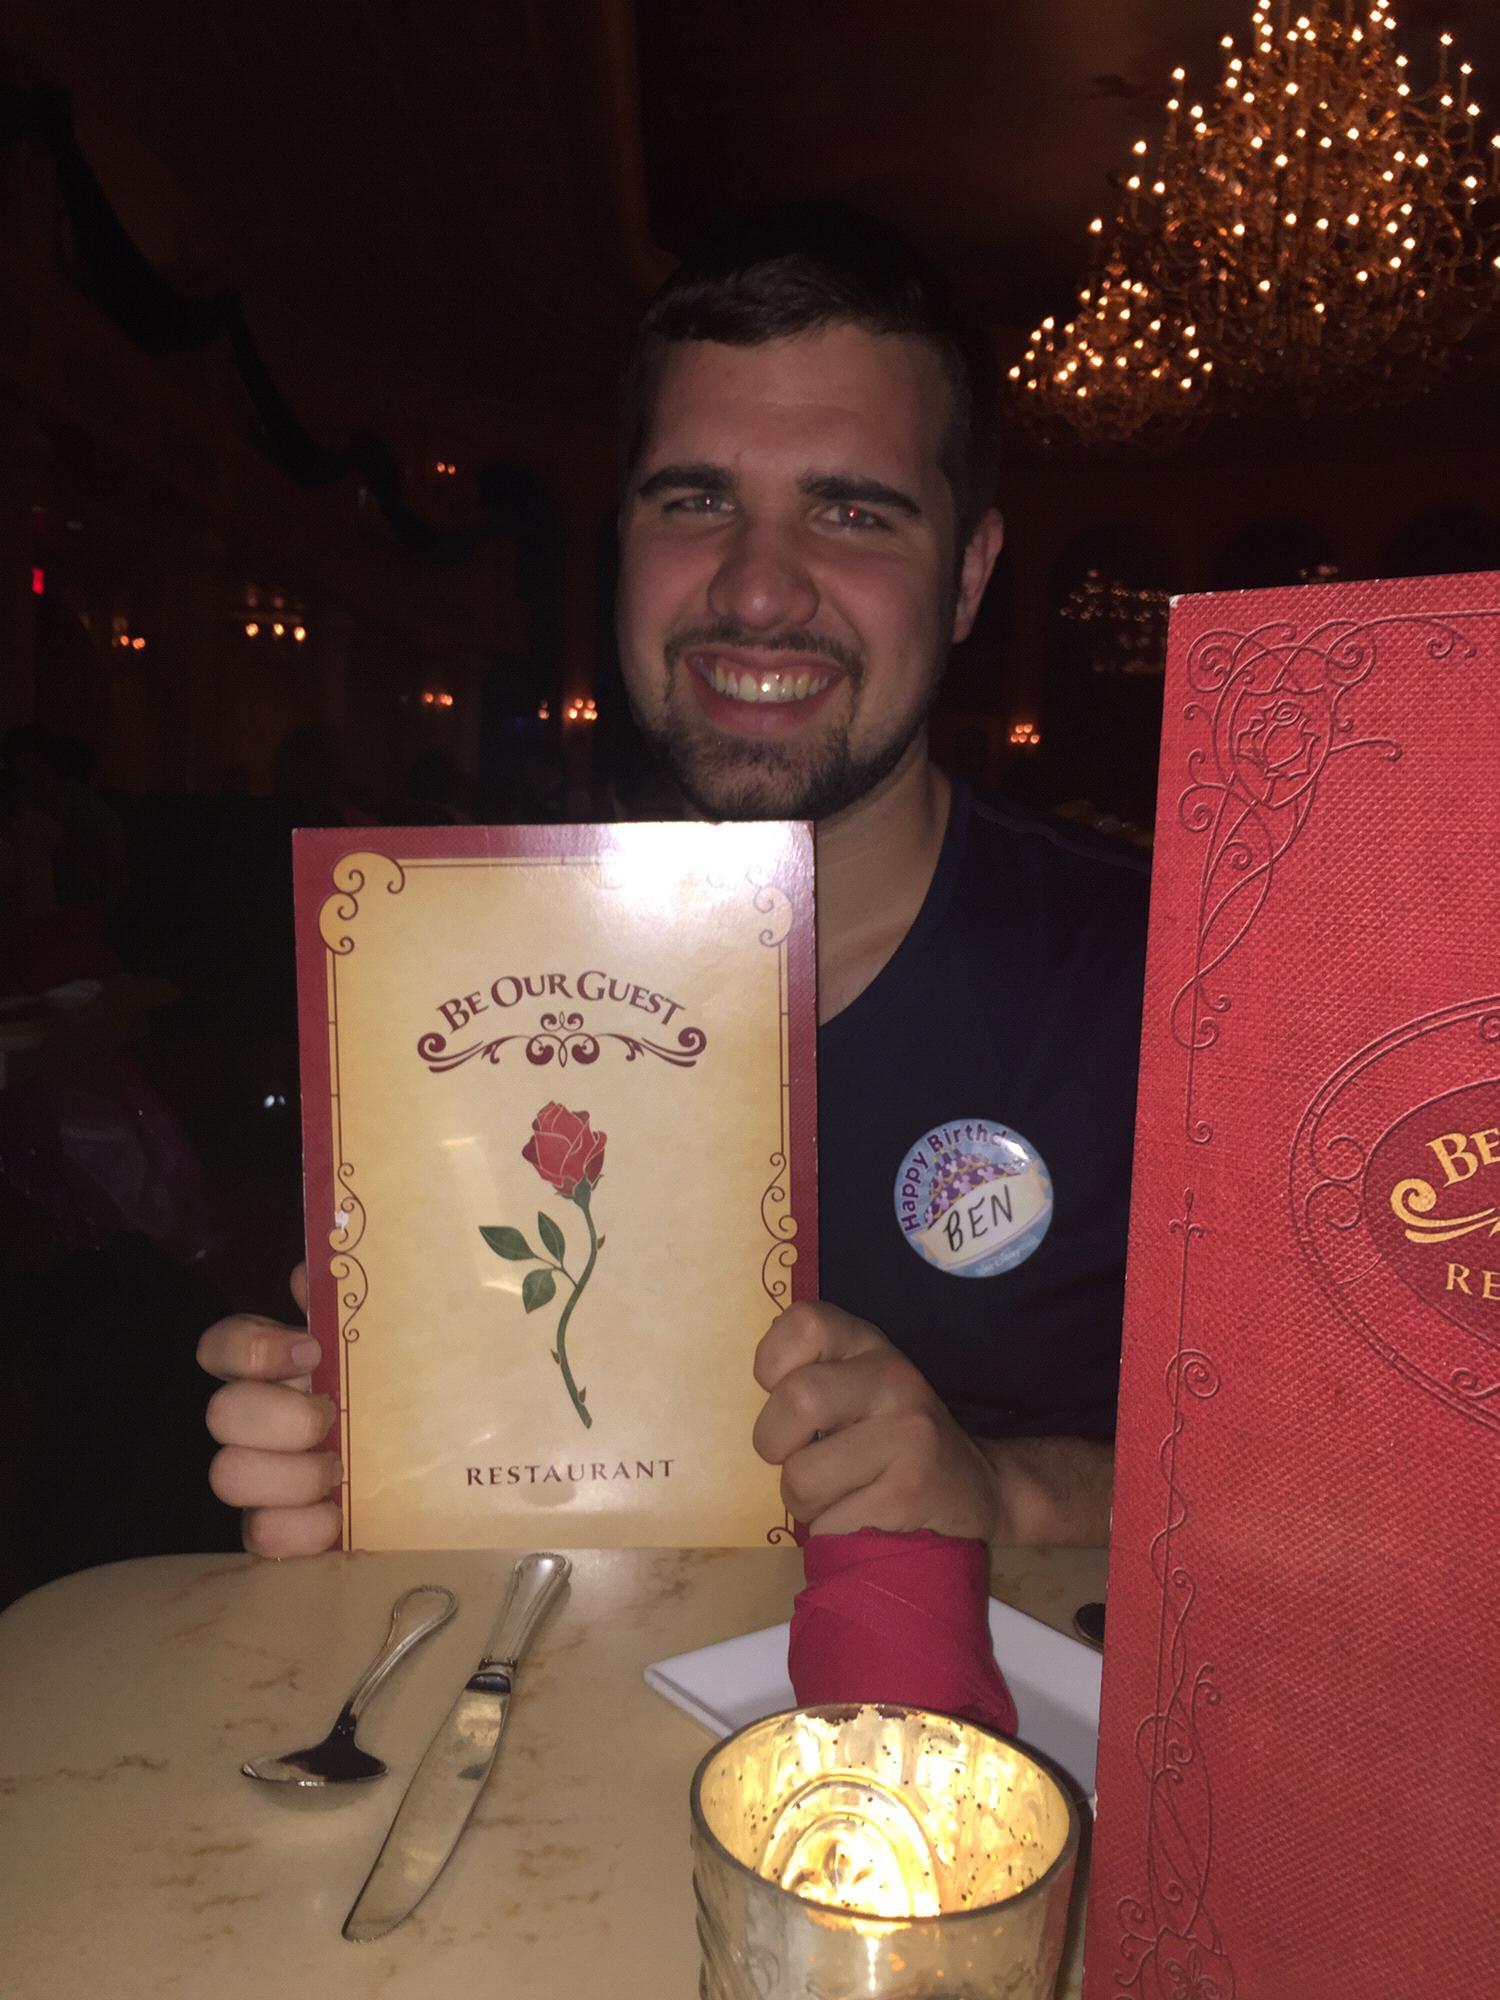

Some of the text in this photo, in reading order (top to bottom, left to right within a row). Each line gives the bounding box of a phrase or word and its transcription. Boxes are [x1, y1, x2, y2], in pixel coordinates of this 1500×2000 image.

[900, 1151, 929, 1232] Happy
[942, 1184, 1013, 1252] BEN
[466, 1459, 675, 1486] RESTAURANT
